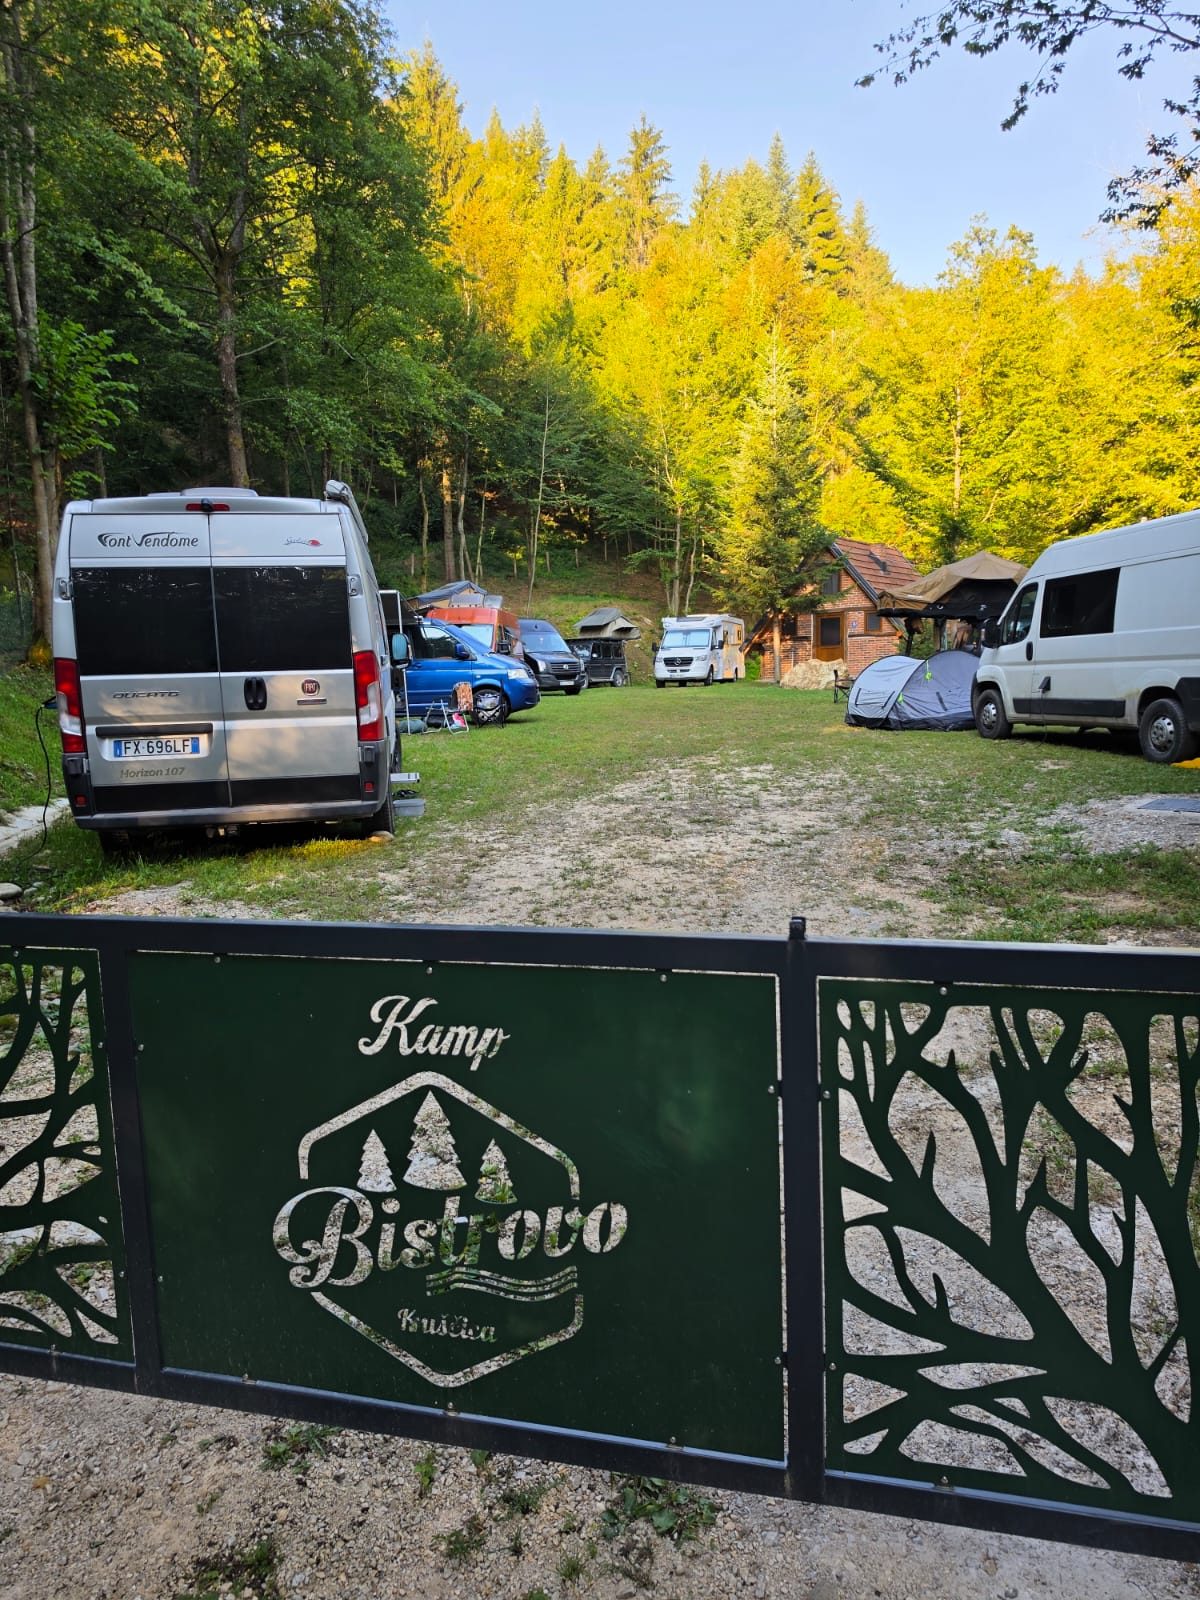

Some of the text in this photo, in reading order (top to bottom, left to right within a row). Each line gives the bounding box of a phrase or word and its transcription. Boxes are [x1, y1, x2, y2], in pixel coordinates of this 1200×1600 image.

[97, 532, 199, 548] Font Vendome
[112, 690, 181, 700] DUCATO
[123, 740, 141, 755] FX
[148, 739, 191, 754] 696LF
[119, 767, 186, 779] Horizon 107
[358, 995, 511, 1071] Kamp
[272, 1186, 628, 1288] Bistrovo
